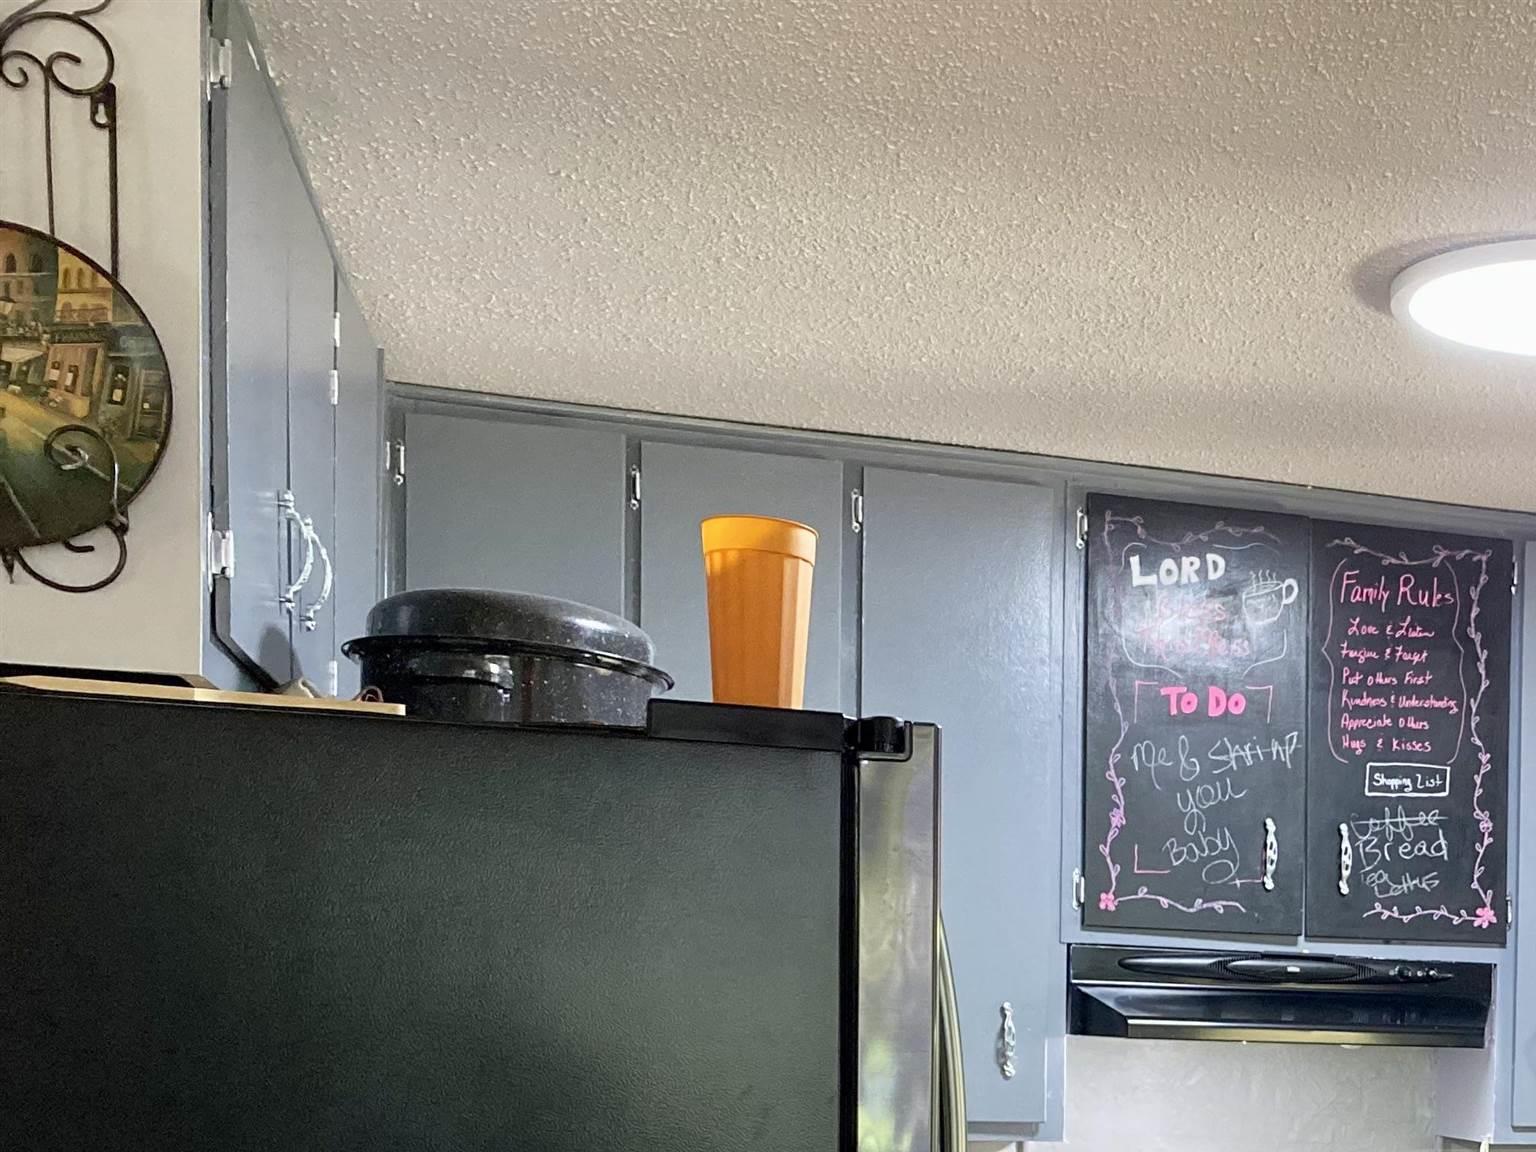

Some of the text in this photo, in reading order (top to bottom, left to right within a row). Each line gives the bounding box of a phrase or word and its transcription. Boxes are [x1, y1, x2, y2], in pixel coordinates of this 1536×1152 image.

[1129, 553, 1226, 587] LORD
[1340, 570, 1454, 613] Family Rules
[1347, 617, 1380, 636] Love
[1342, 667, 1364, 685] Put
[1403, 671, 1433, 686] First
[1341, 689, 1387, 711] Kindness
[1398, 695, 1459, 714] Understanding
[1340, 713, 1393, 731] Appreciate
[1177, 735, 1200, 781] &
[1342, 736, 1367, 755] Hugs
[1392, 738, 1432, 752] Kisses
[1373, 772, 1444, 792] Shopping List
[1161, 827, 1241, 885] Baby
[1355, 828, 1449, 874] Bread
